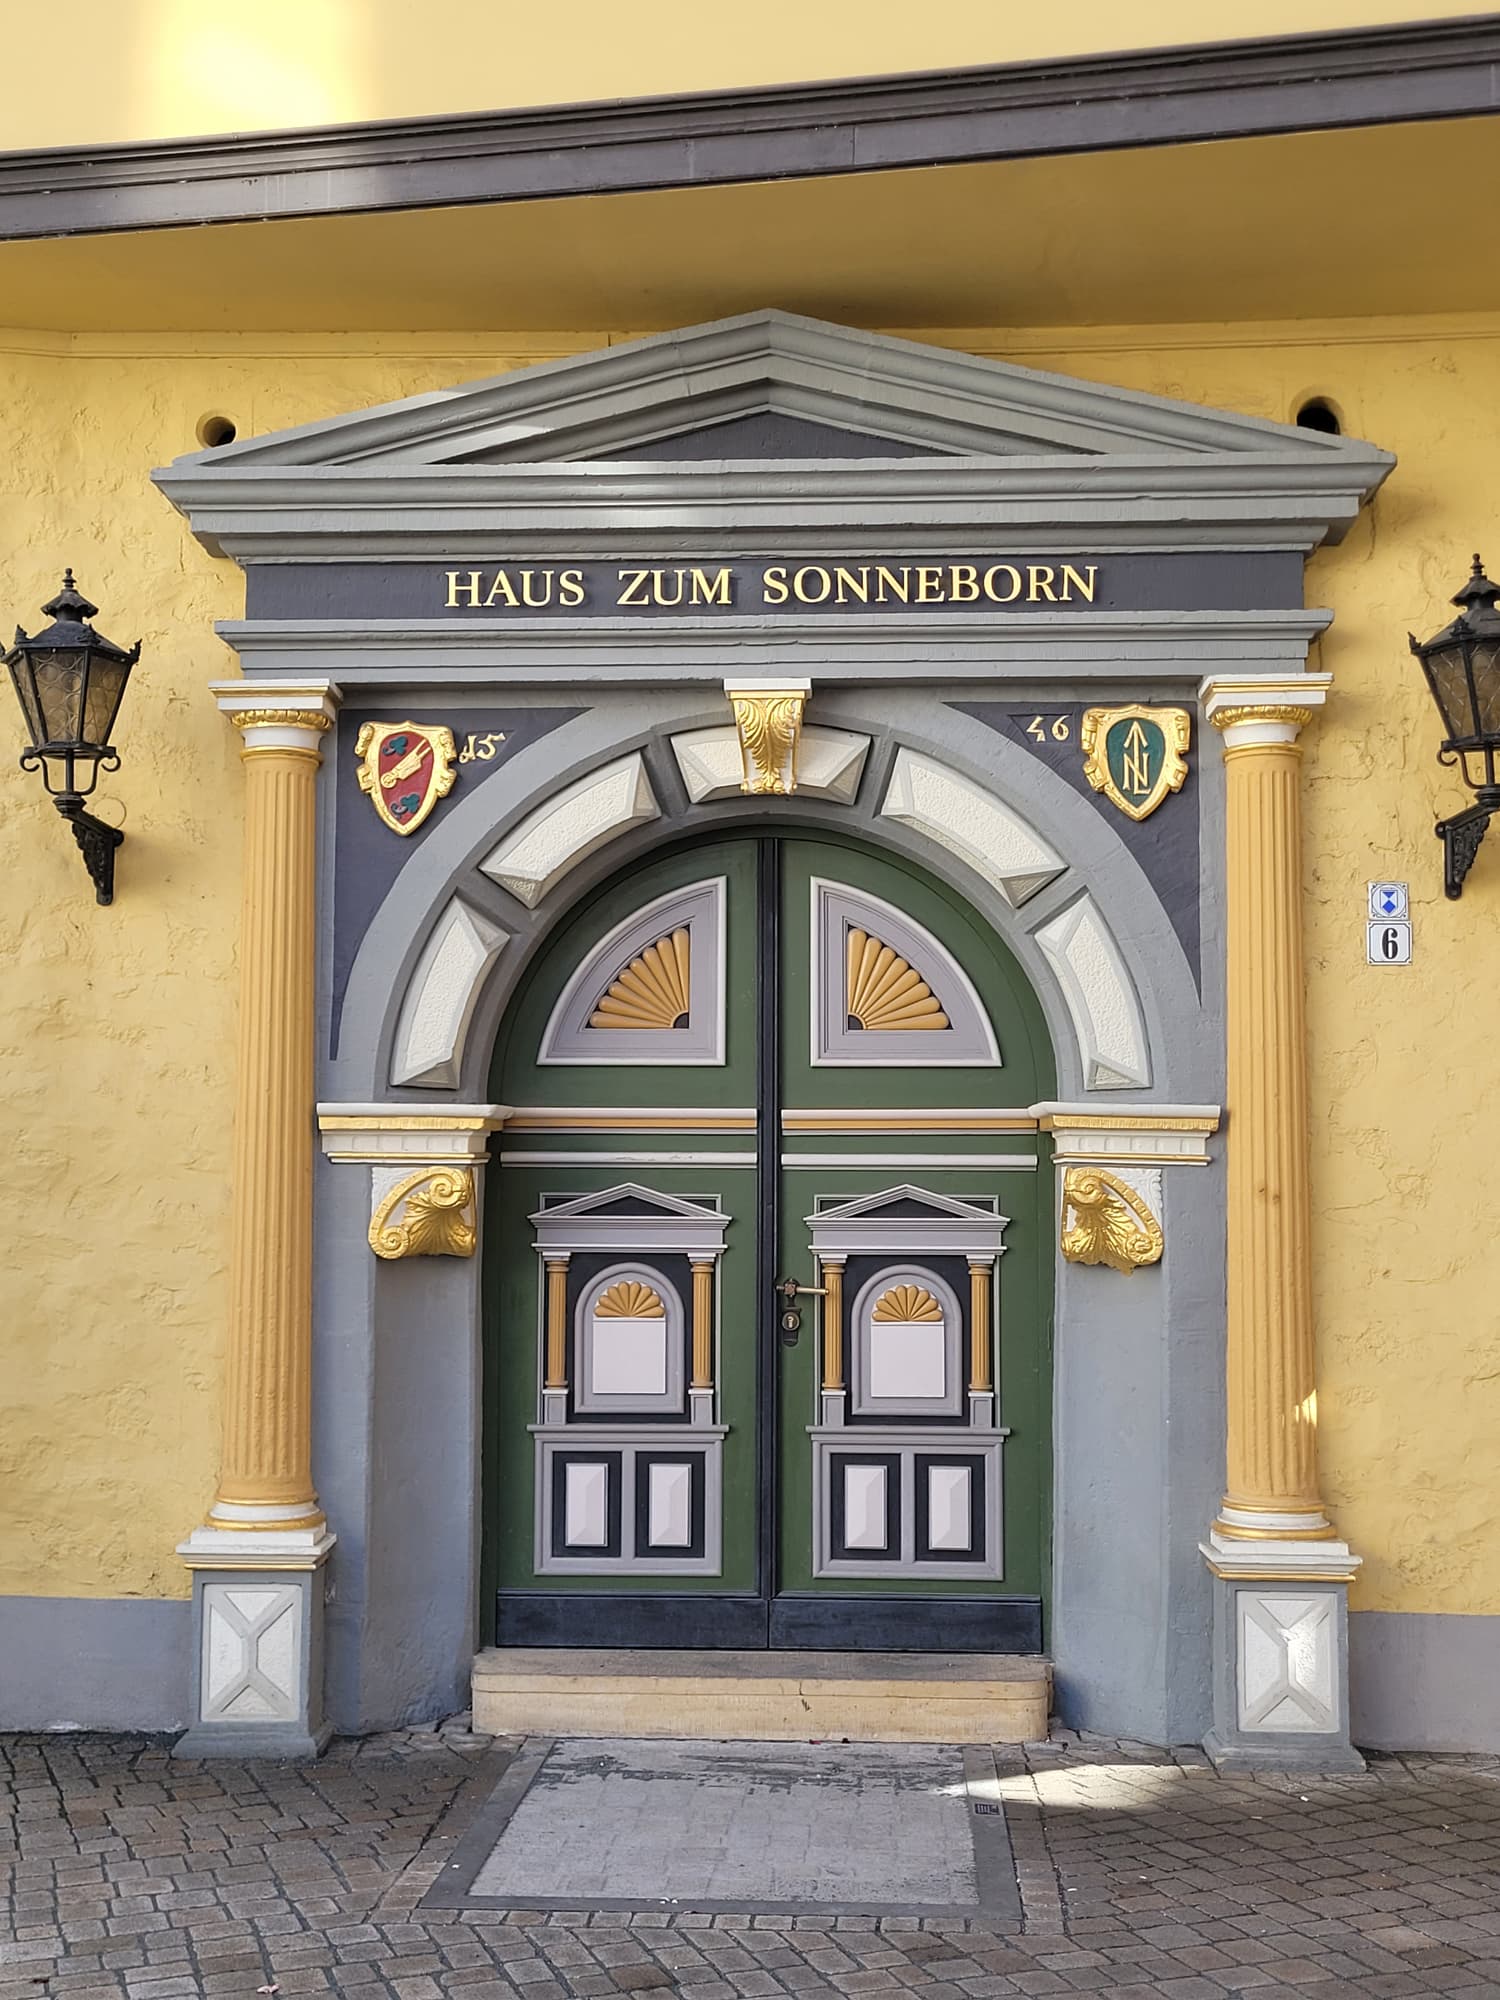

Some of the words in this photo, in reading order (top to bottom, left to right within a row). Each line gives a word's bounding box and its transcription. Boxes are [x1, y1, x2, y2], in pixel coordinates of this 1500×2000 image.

[444, 570, 586, 608] HAUS
[616, 568, 733, 606] ZUM
[762, 564, 1099, 604] SONNEBORN
[1026, 715, 1070, 742] 46
[1381, 927, 1399, 960] 6
